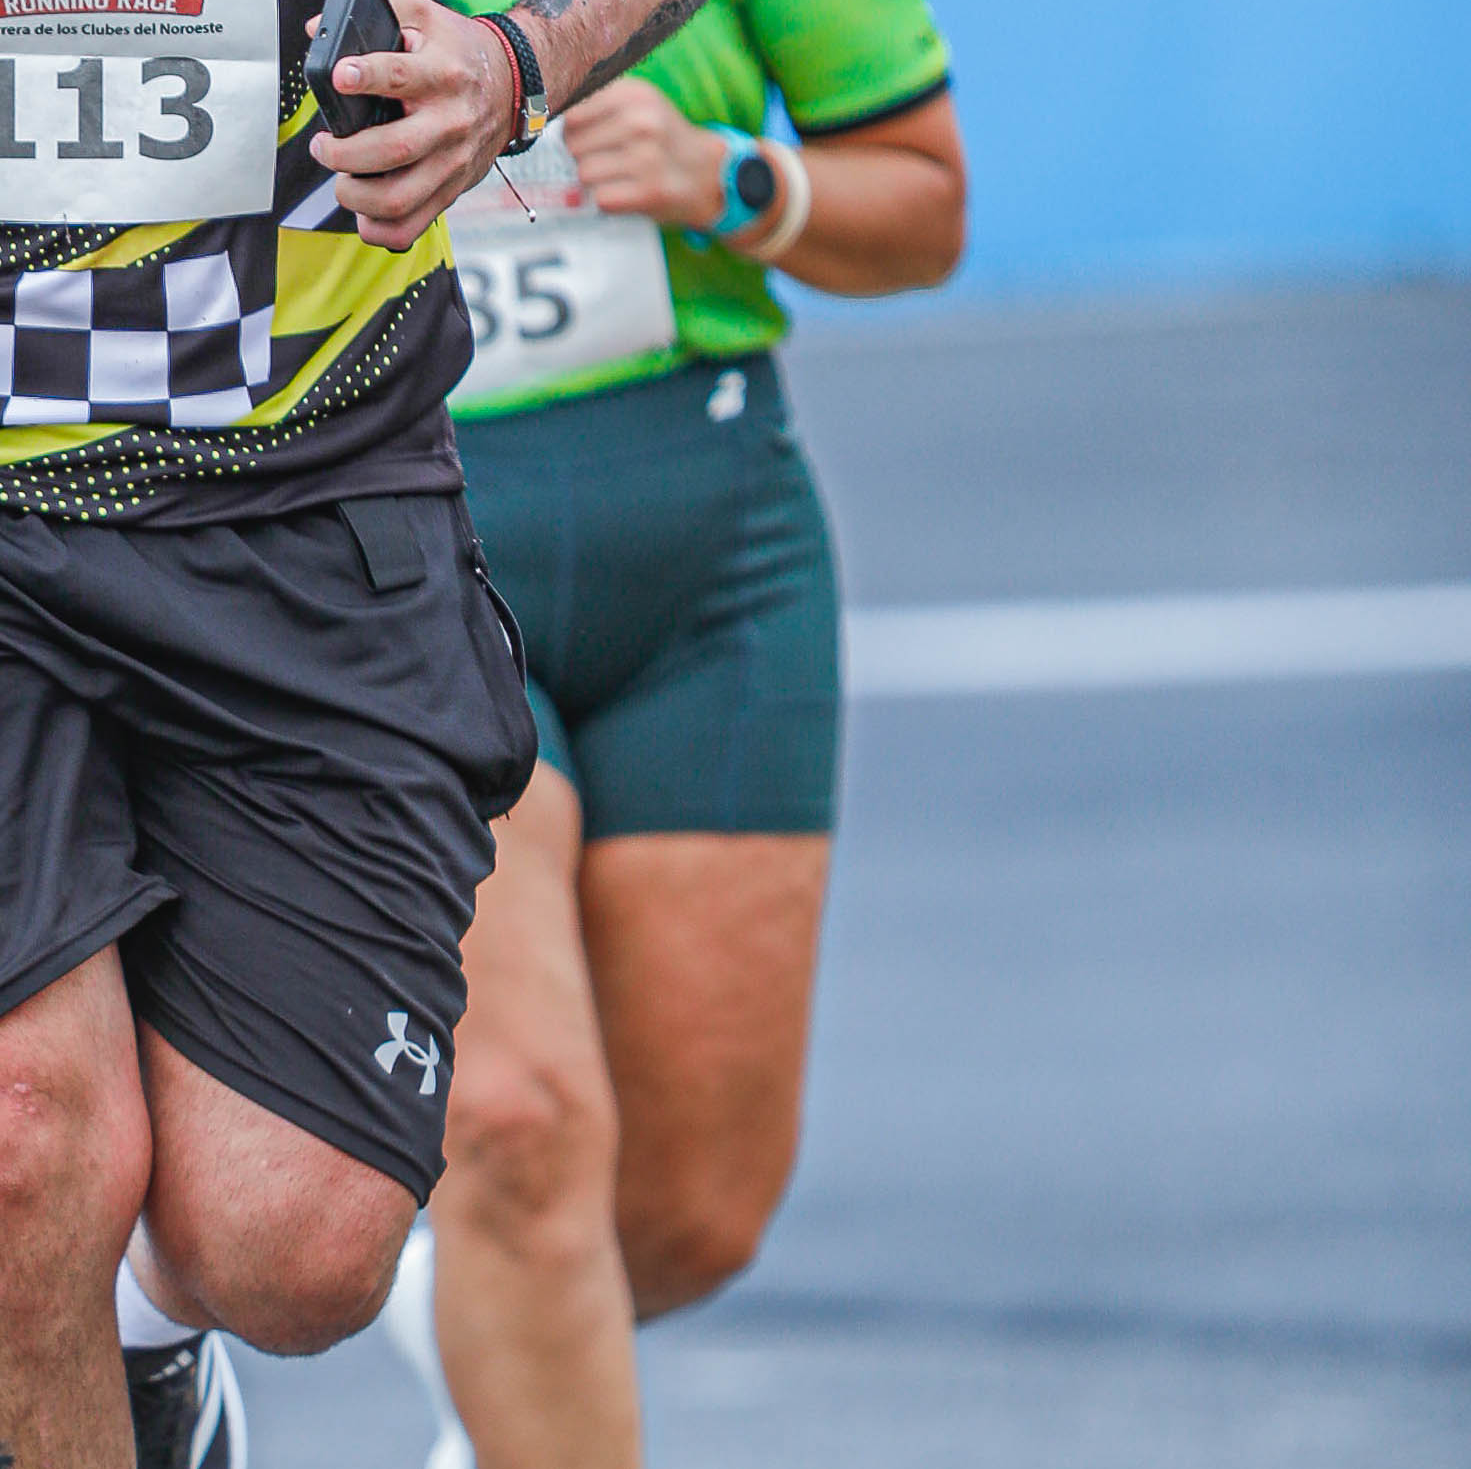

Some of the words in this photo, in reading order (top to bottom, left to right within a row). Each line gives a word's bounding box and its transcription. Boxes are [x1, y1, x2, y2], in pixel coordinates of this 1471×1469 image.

[34, 23, 53, 35] de
[57, 22, 77, 35] los
[81, 22, 130, 35] Clubes
[134, 22, 156, 35] del
[160, 21, 224, 35] Noroeste
